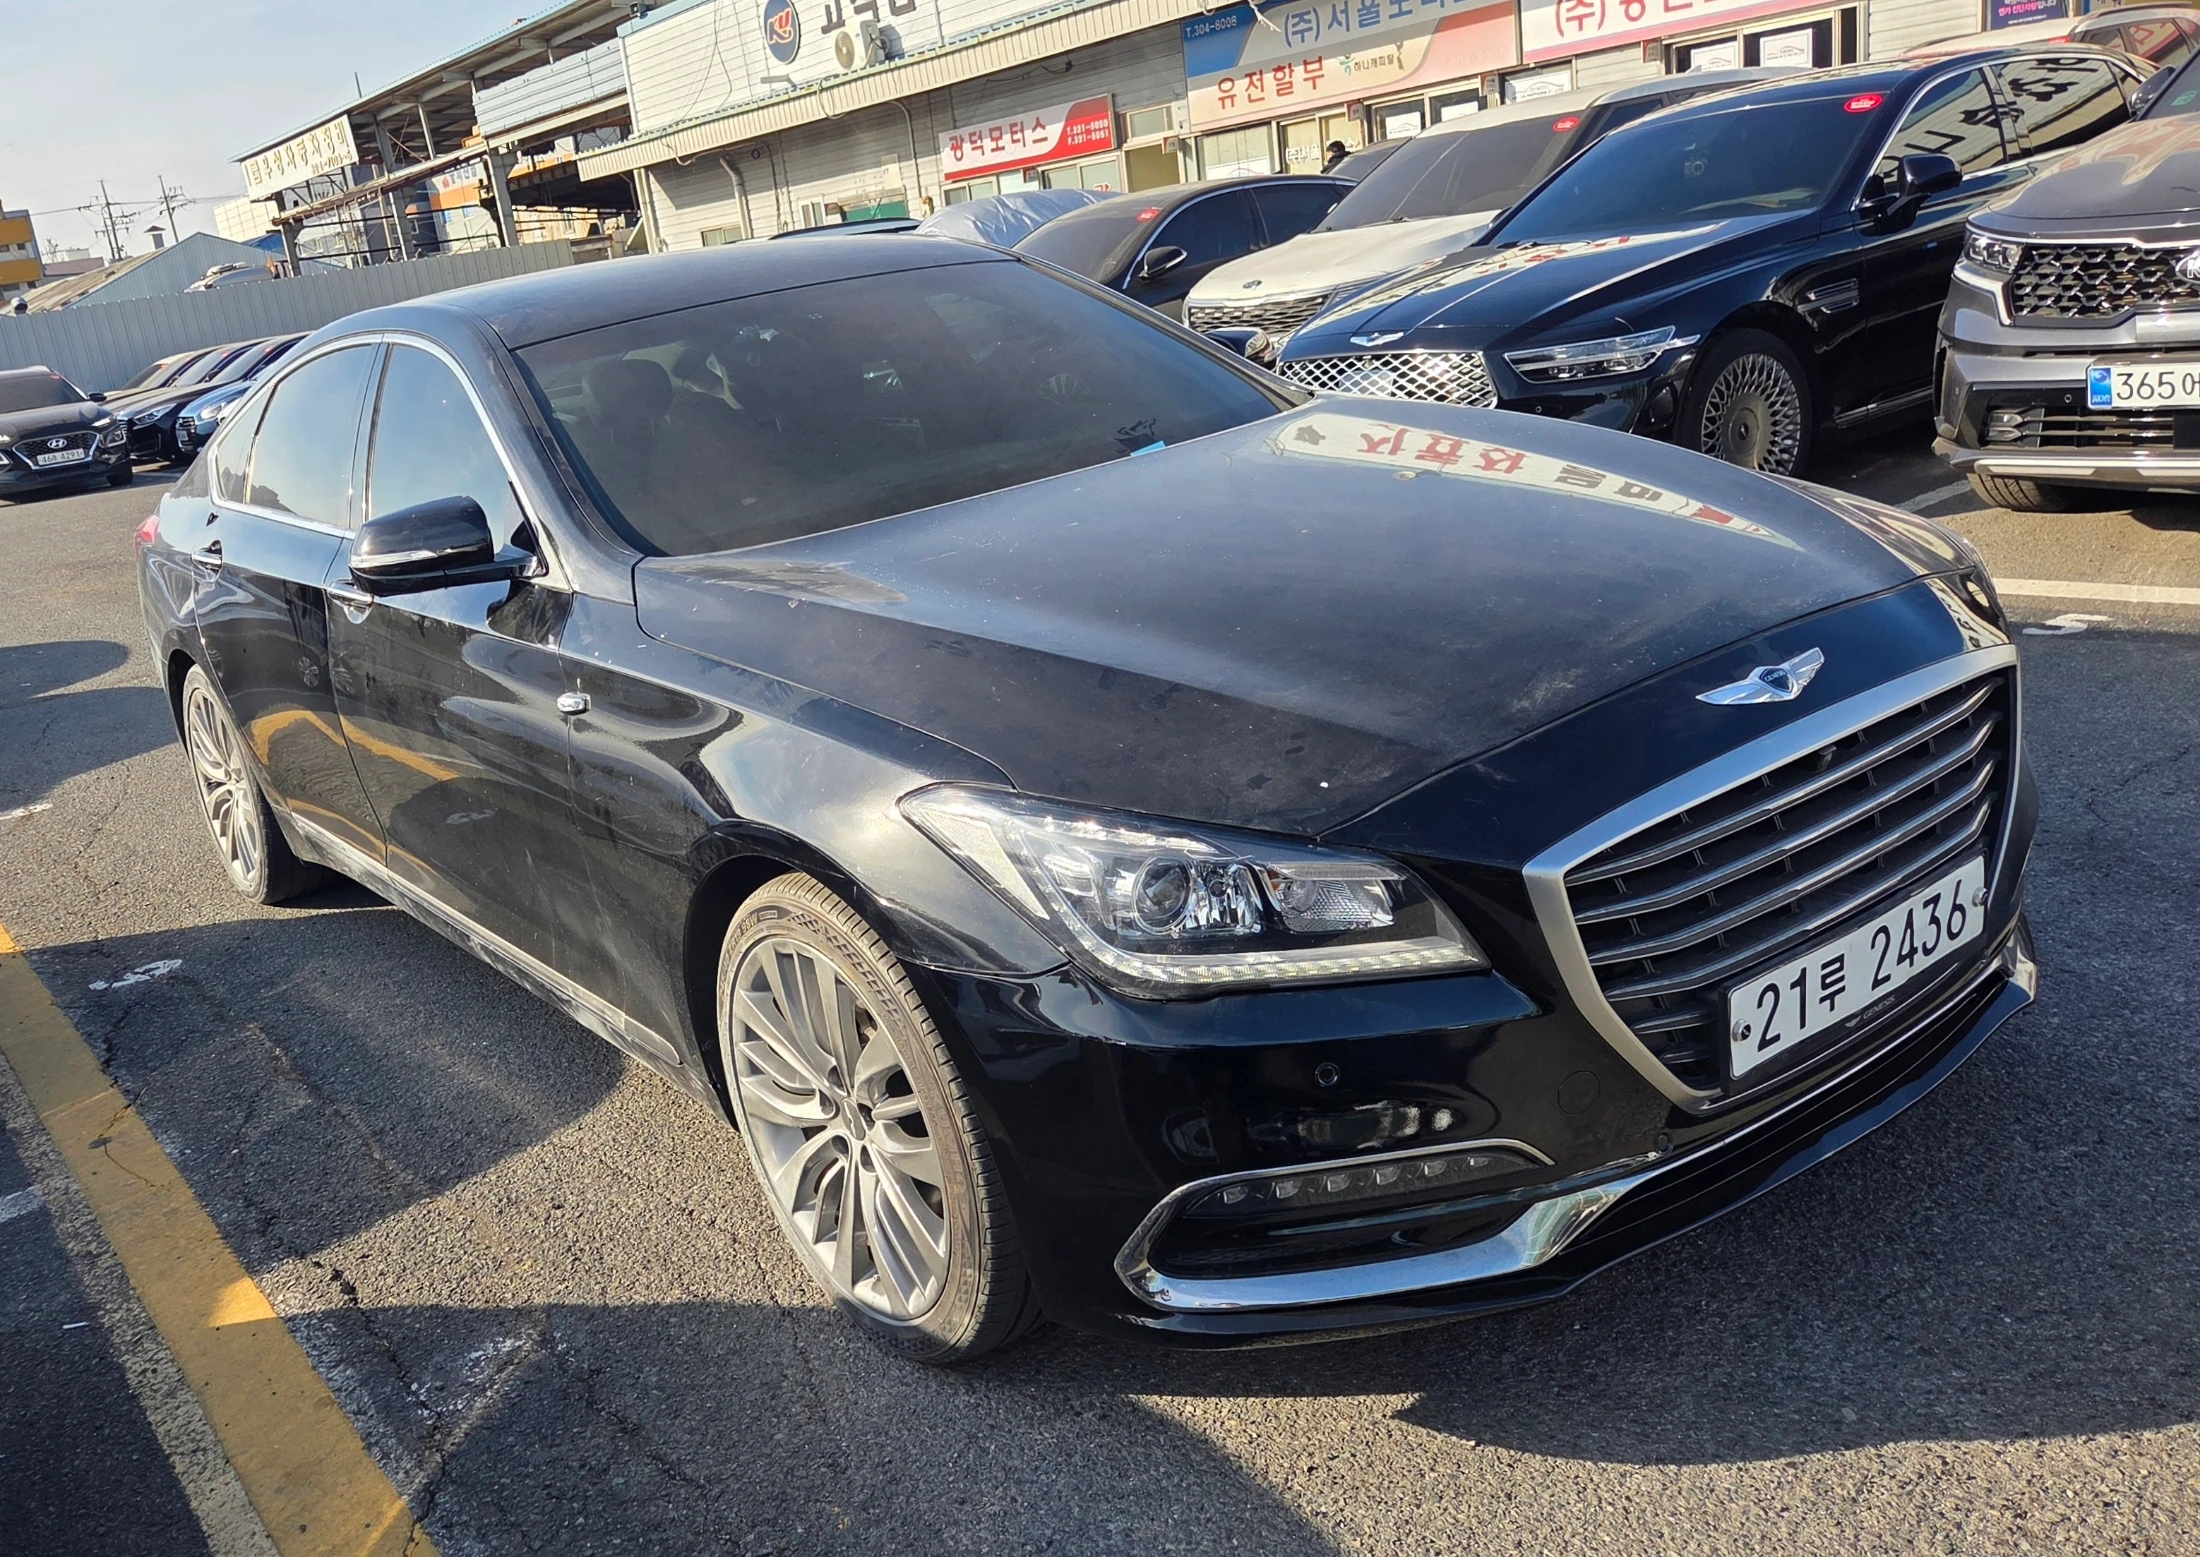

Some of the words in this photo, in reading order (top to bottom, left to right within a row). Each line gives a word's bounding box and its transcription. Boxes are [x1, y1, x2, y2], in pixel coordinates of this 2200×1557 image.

[1185, 15, 1237, 38] T.304-8008
[1284, 0, 1467, 48] (주)서울모
[1353, 53, 1394, 72] 하나캐피탈
[1217, 55, 1325, 110] 유전할부
[948, 116, 1049, 162] 광덕모터스
[1066, 118, 1109, 137] T.321-5050
[1067, 129, 1109, 146] F.321-5051
[61, 451, 80, 460] 4291
[1756, 952, 1846, 1053] 21루
[1870, 879, 1967, 992] 2436
[1863, 994, 1896, 1020] GENESIS
